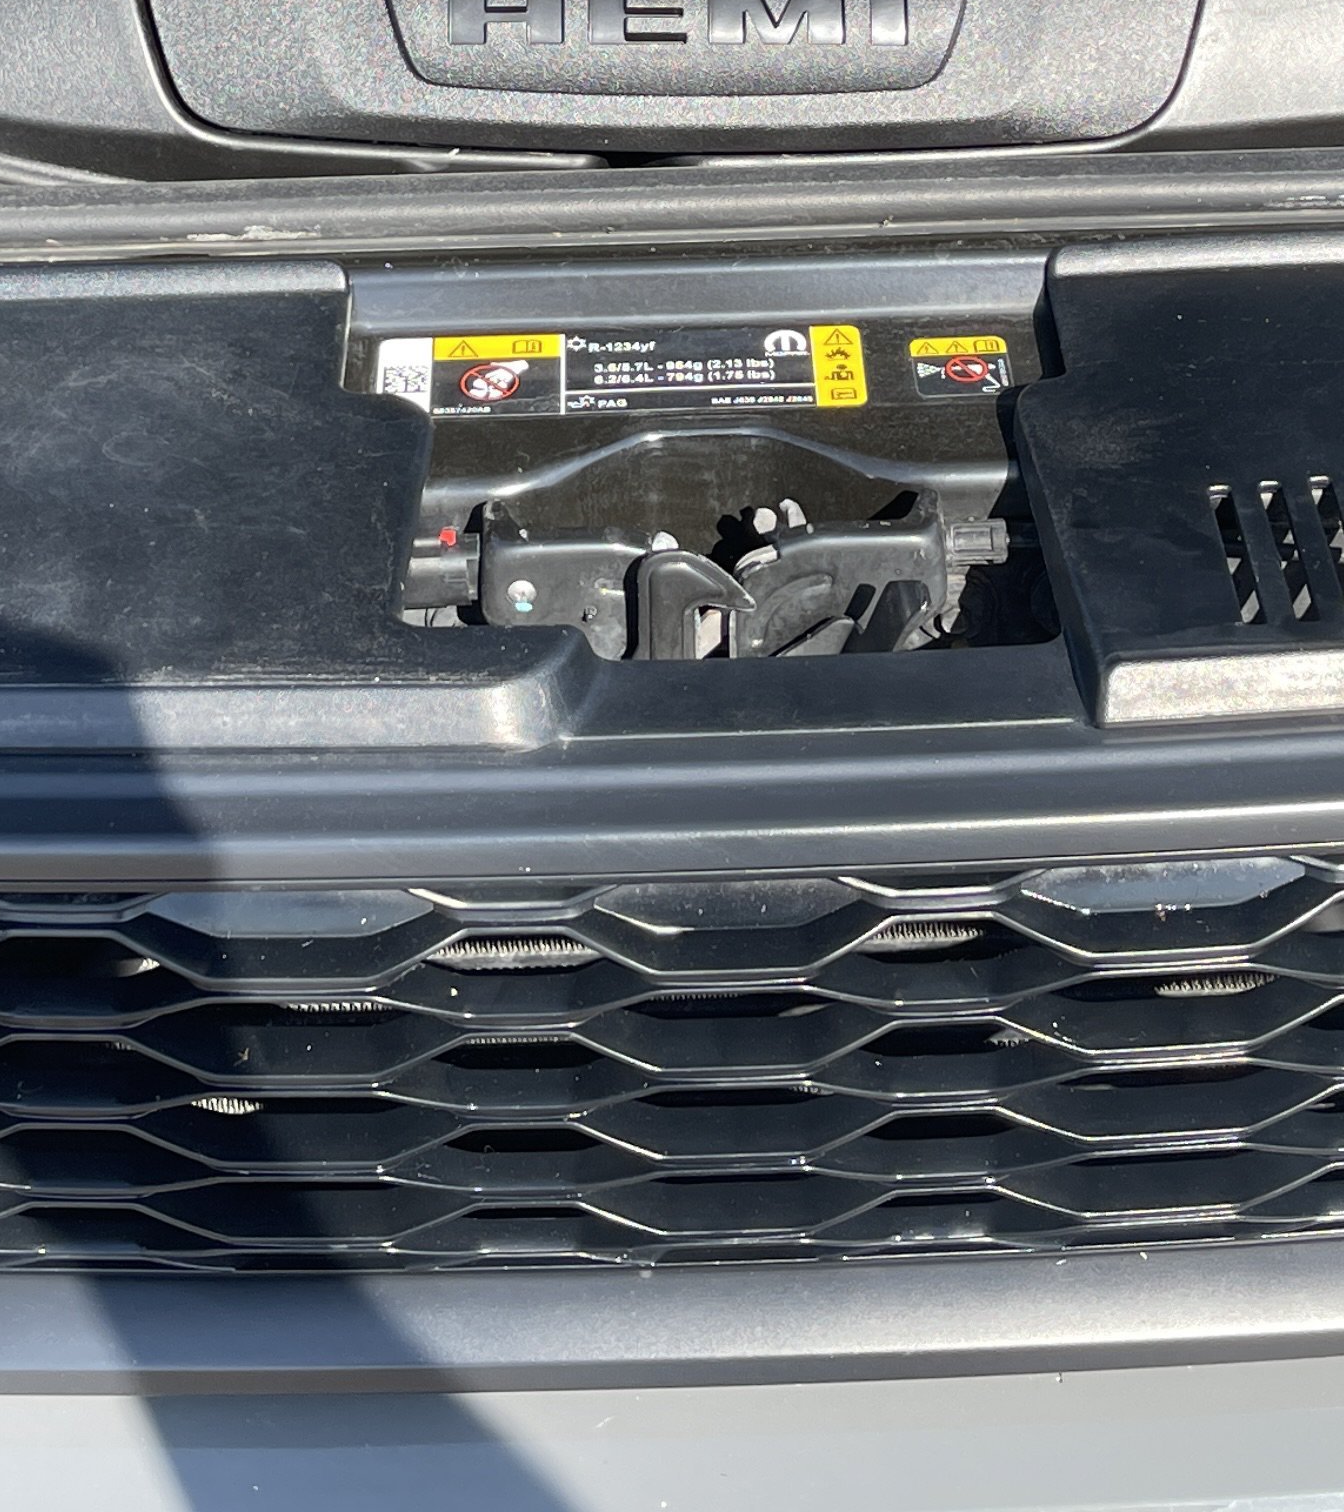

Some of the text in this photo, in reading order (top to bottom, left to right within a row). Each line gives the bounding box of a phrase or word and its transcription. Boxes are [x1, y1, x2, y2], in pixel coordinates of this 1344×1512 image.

[588, 341, 656, 353] R-1234yf
[746, 358, 775, 369] lbs)
[747, 369, 776, 381] lbs)
[597, 398, 628, 408] PAG
